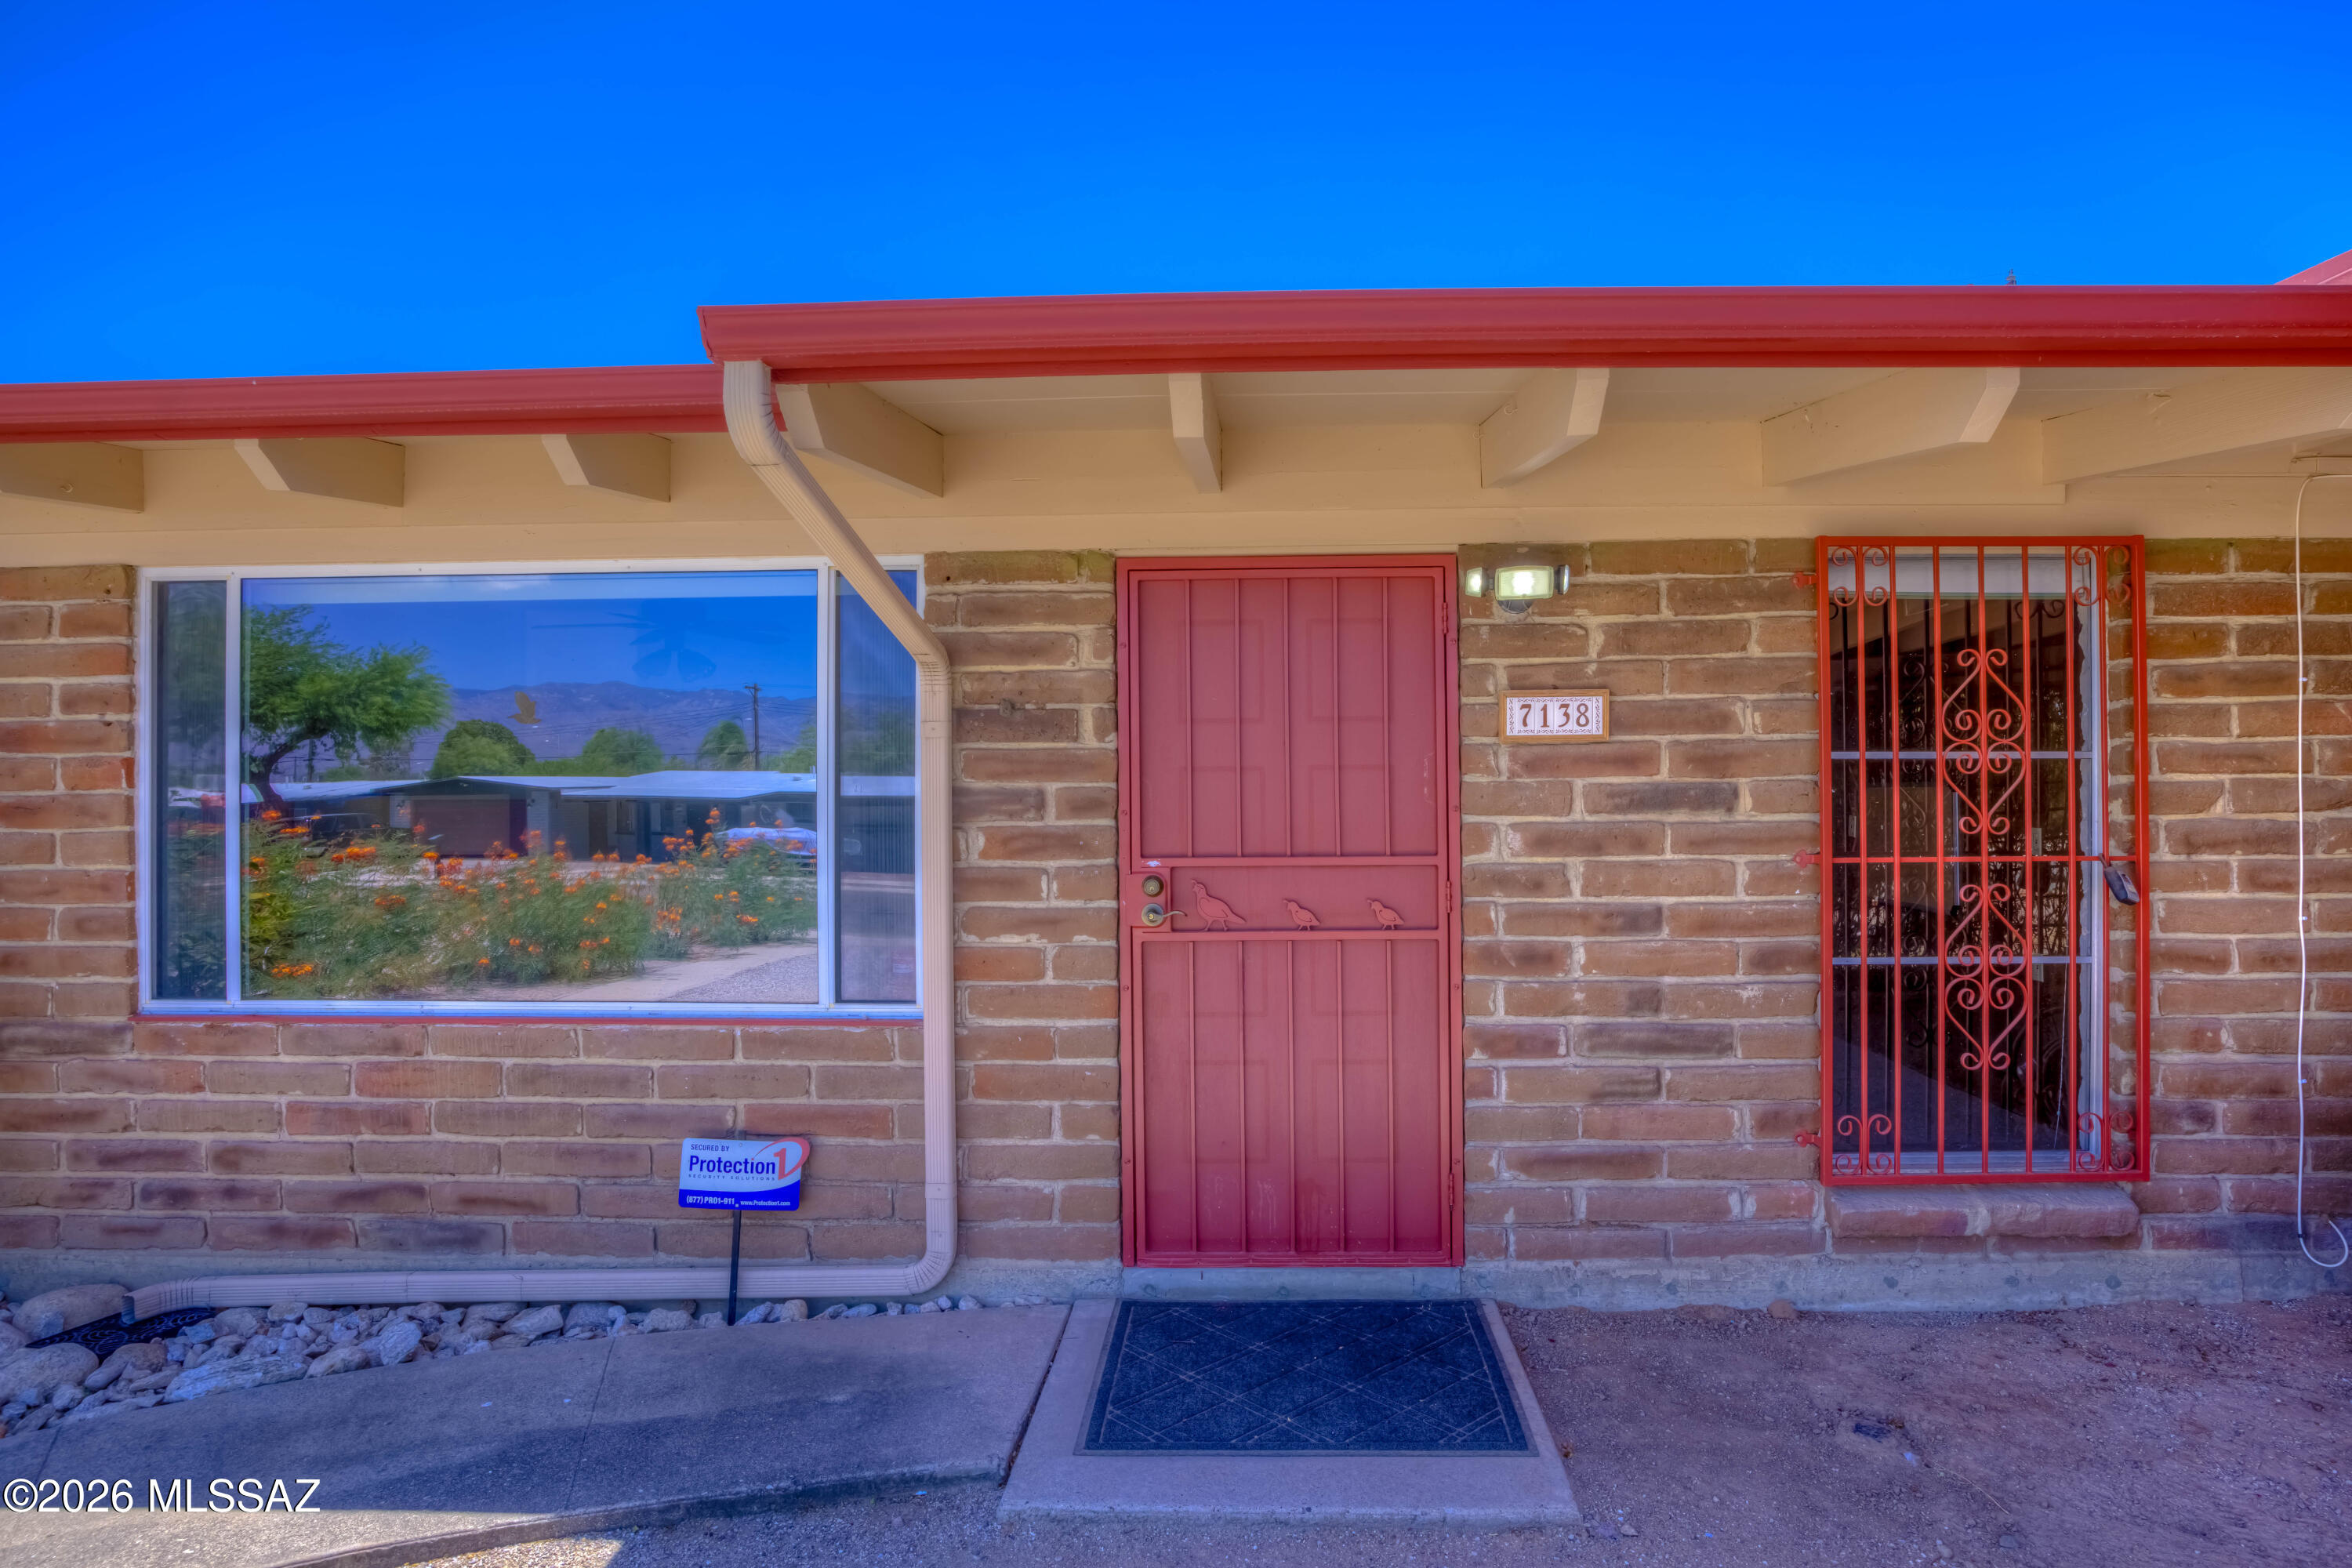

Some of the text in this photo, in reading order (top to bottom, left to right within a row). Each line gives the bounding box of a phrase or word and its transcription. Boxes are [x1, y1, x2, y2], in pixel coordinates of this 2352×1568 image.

[1519, 702, 1590, 728] 7138
[689, 1148, 787, 1181] Protection 1
[686, 1195, 704, 1204] (877)
